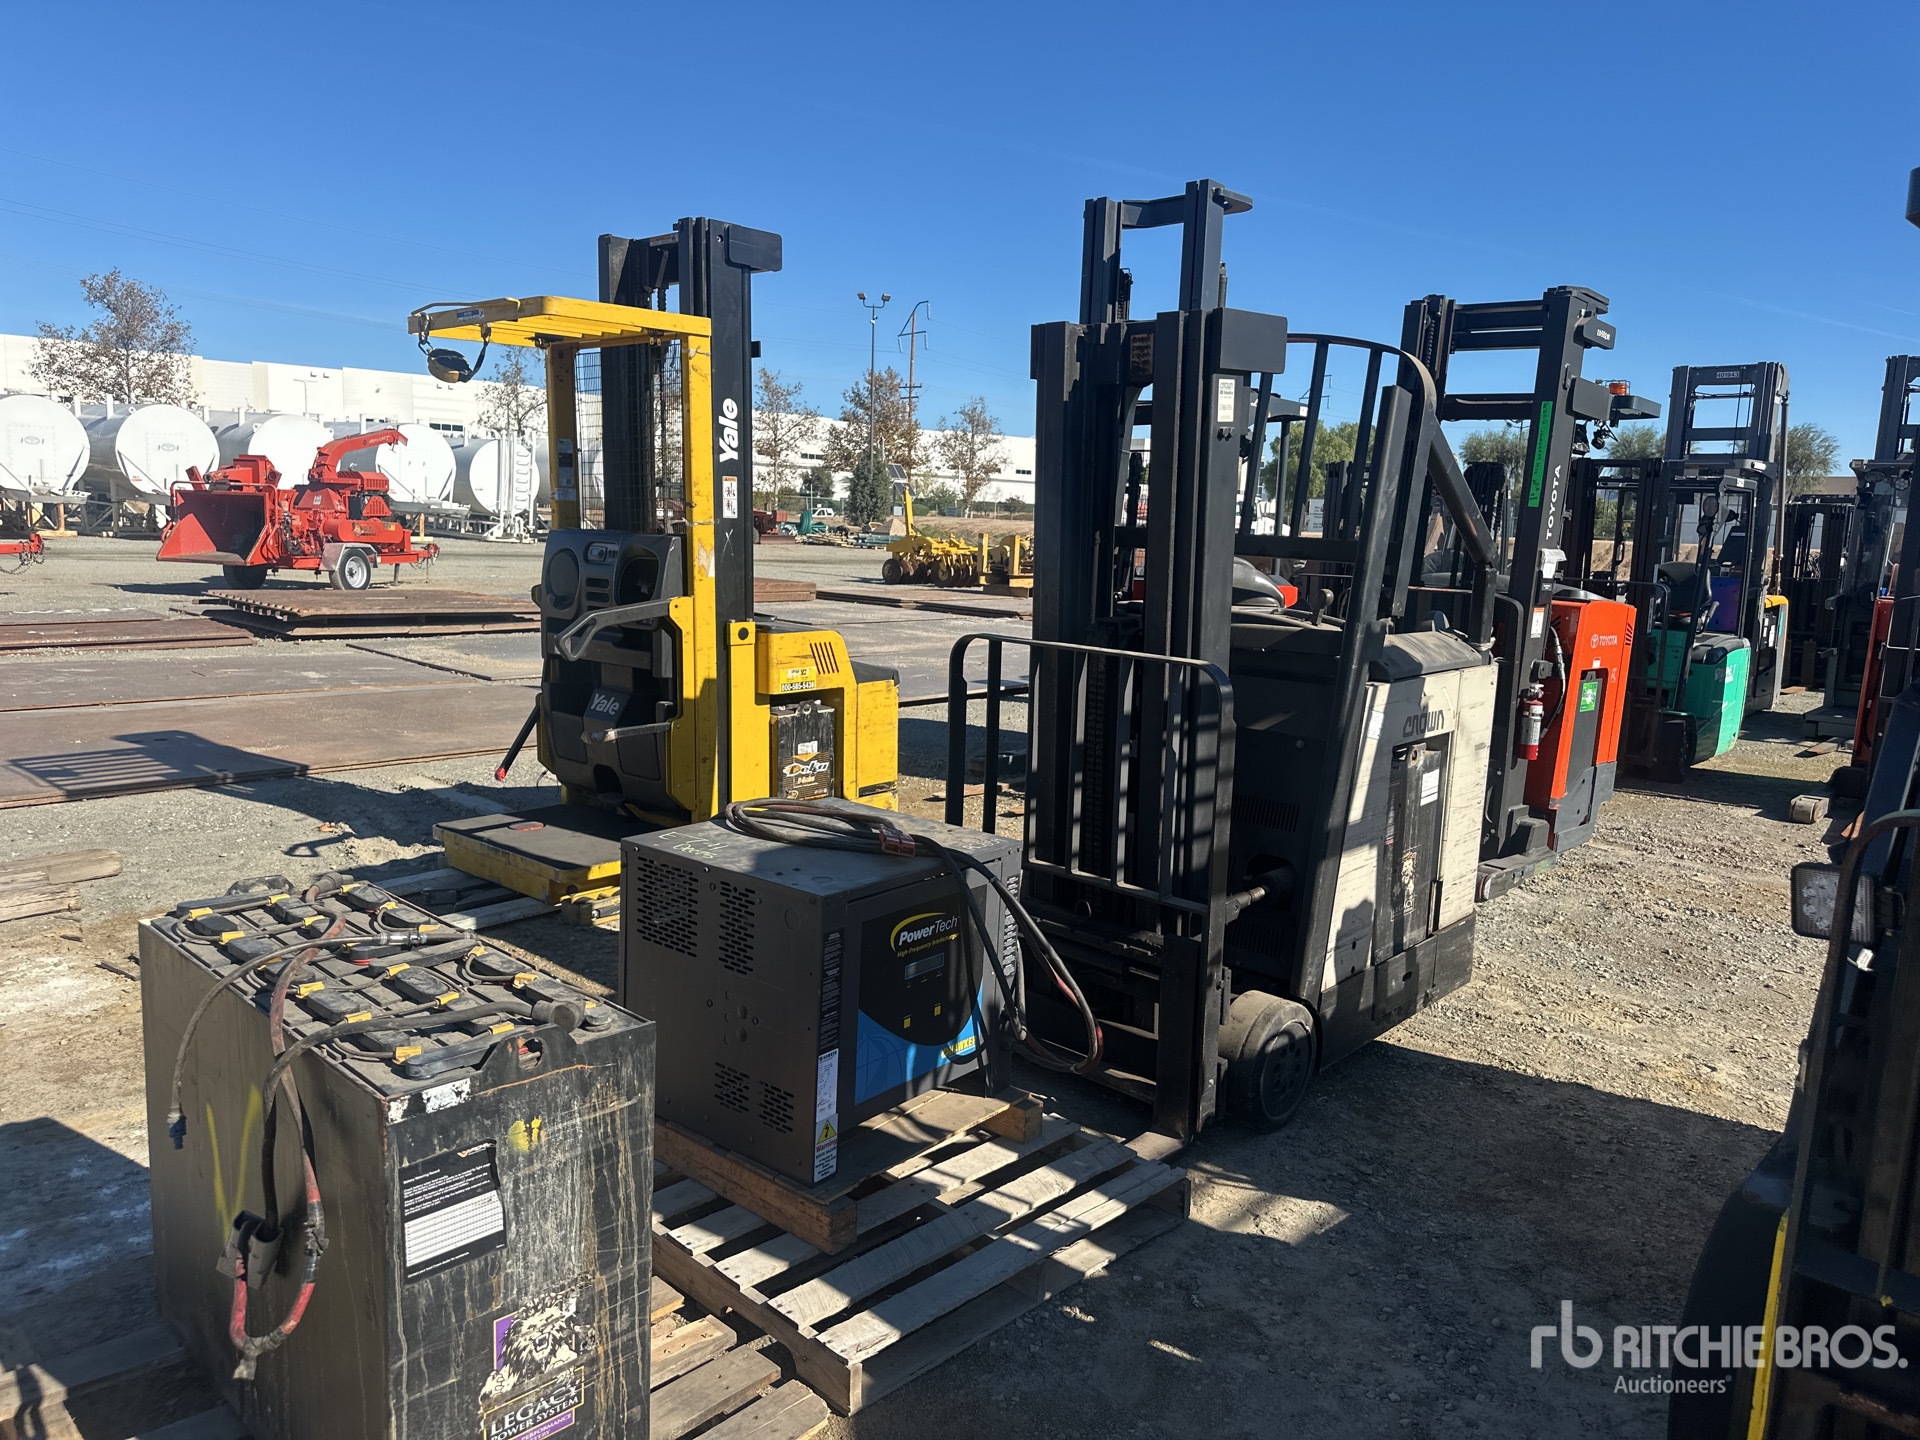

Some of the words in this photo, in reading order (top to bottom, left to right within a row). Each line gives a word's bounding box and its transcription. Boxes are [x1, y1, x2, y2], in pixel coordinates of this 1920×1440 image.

[718, 397, 739, 463] Yale
[1545, 464, 1562, 541] TOYOTA
[1600, 635, 1618, 646] TOYOTA
[590, 692, 620, 716] Yale
[1402, 711, 1445, 738] CROWN
[898, 916, 958, 946] PowerTech
[815, 1138, 838, 1153] Warning
[490, 1378, 581, 1436] LEGACY
[536, 1396, 579, 1423] SYSTEM
